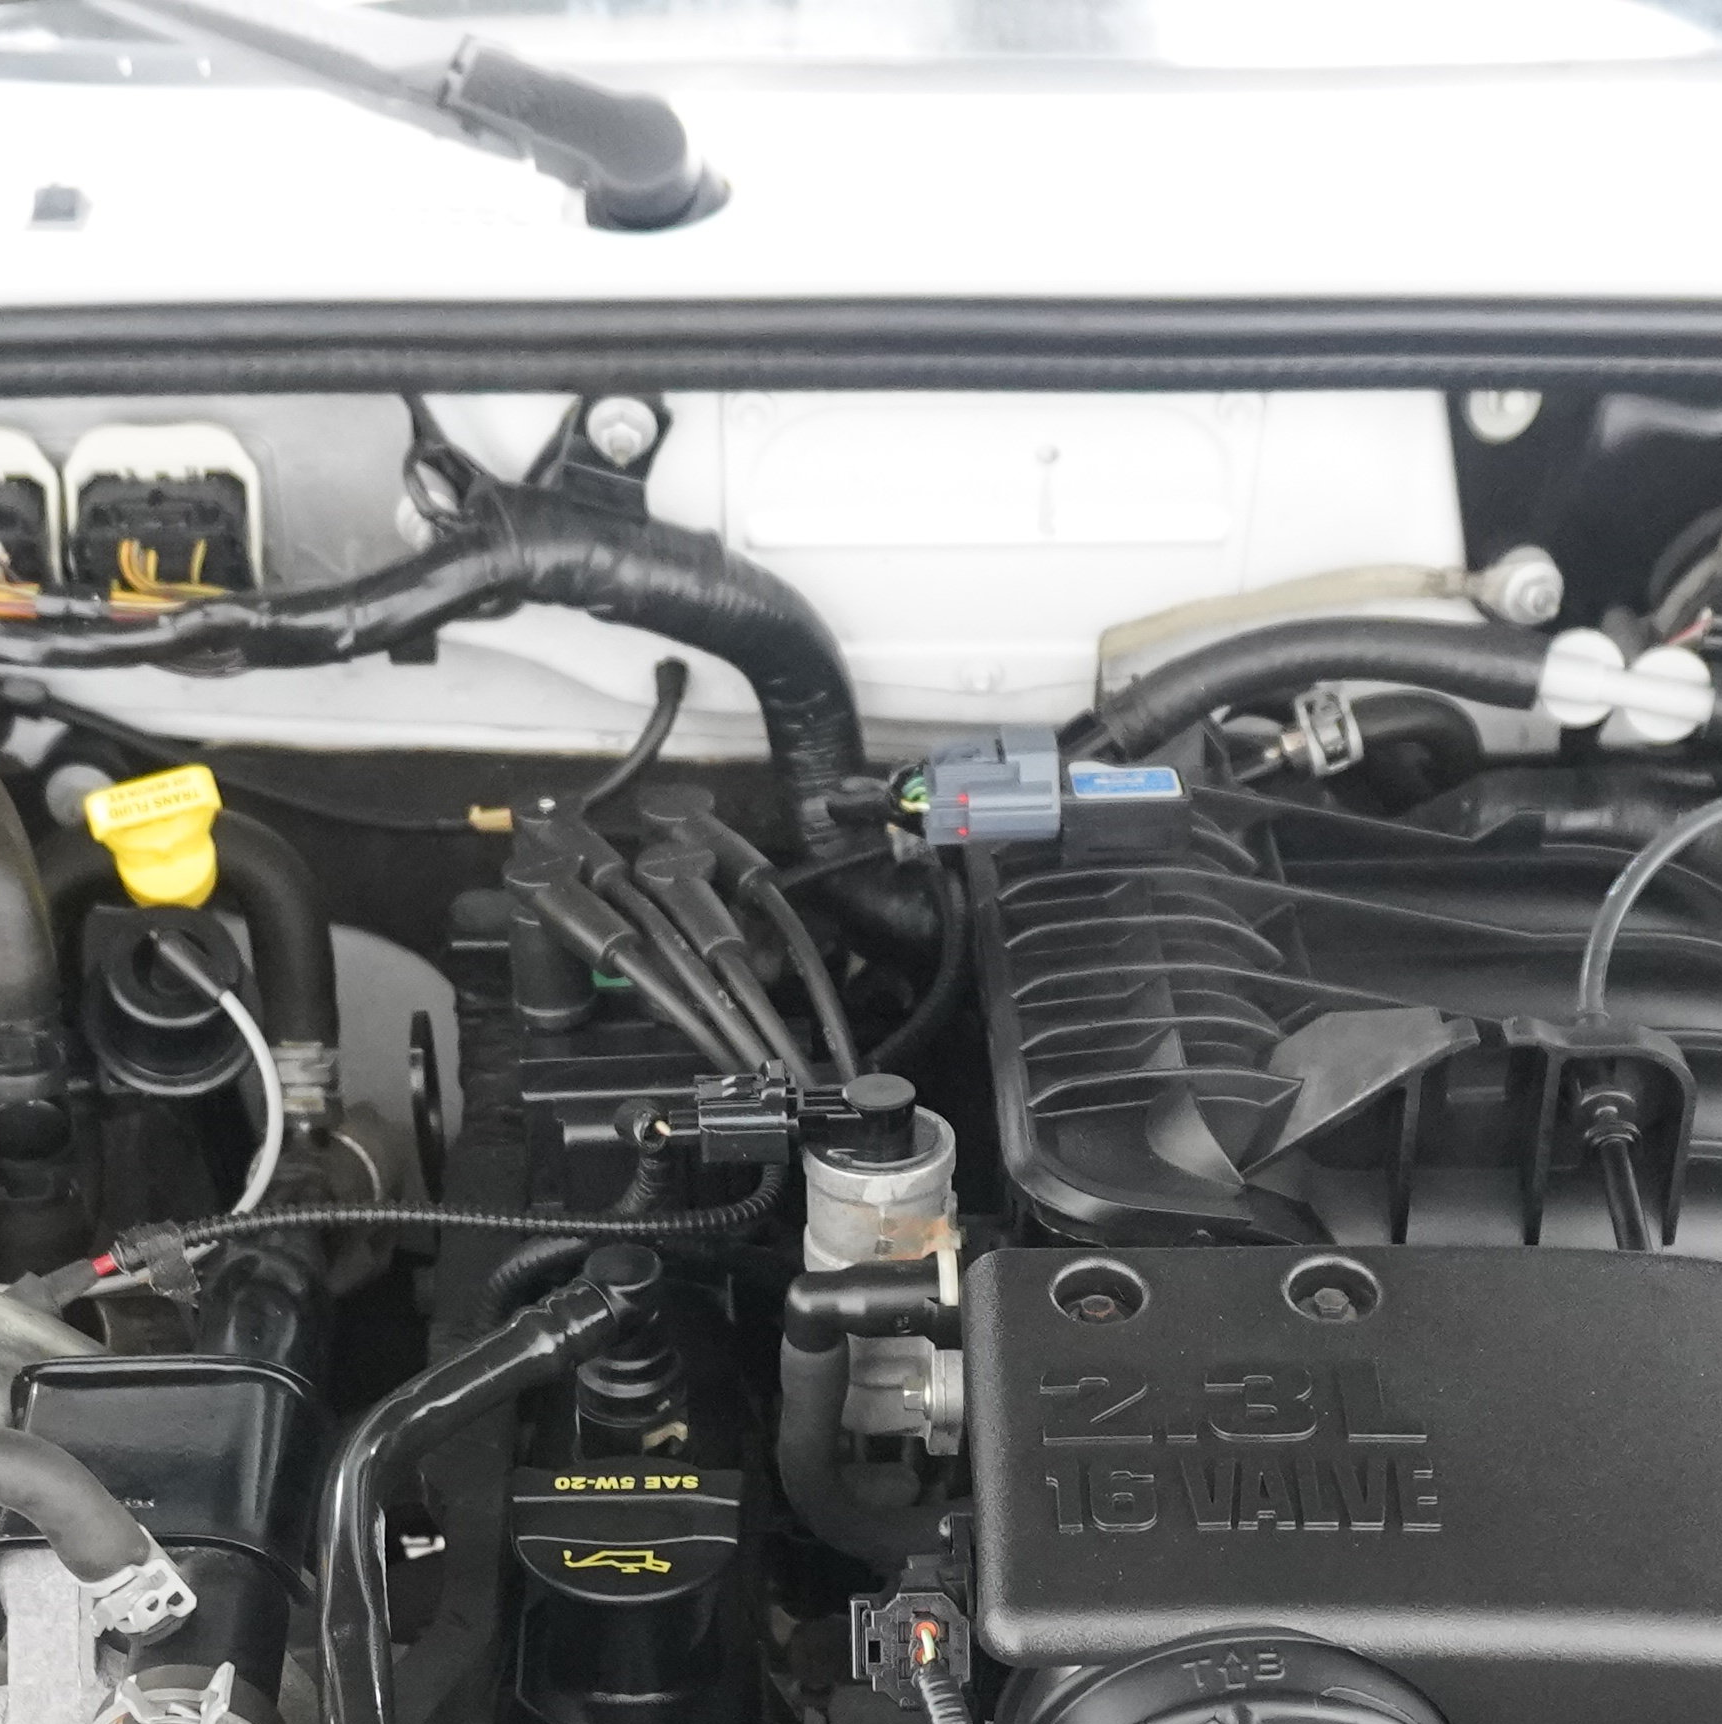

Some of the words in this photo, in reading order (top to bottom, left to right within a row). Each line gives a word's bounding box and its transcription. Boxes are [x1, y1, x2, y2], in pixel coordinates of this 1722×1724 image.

[1039, 1360, 1429, 1445] 2.3L
[554, 1475, 636, 1491] 5W-20
[643, 1475, 700, 1490] SAE
[1045, 1459, 1158, 1533] 16
[1179, 1455, 1443, 1533] VALVE
